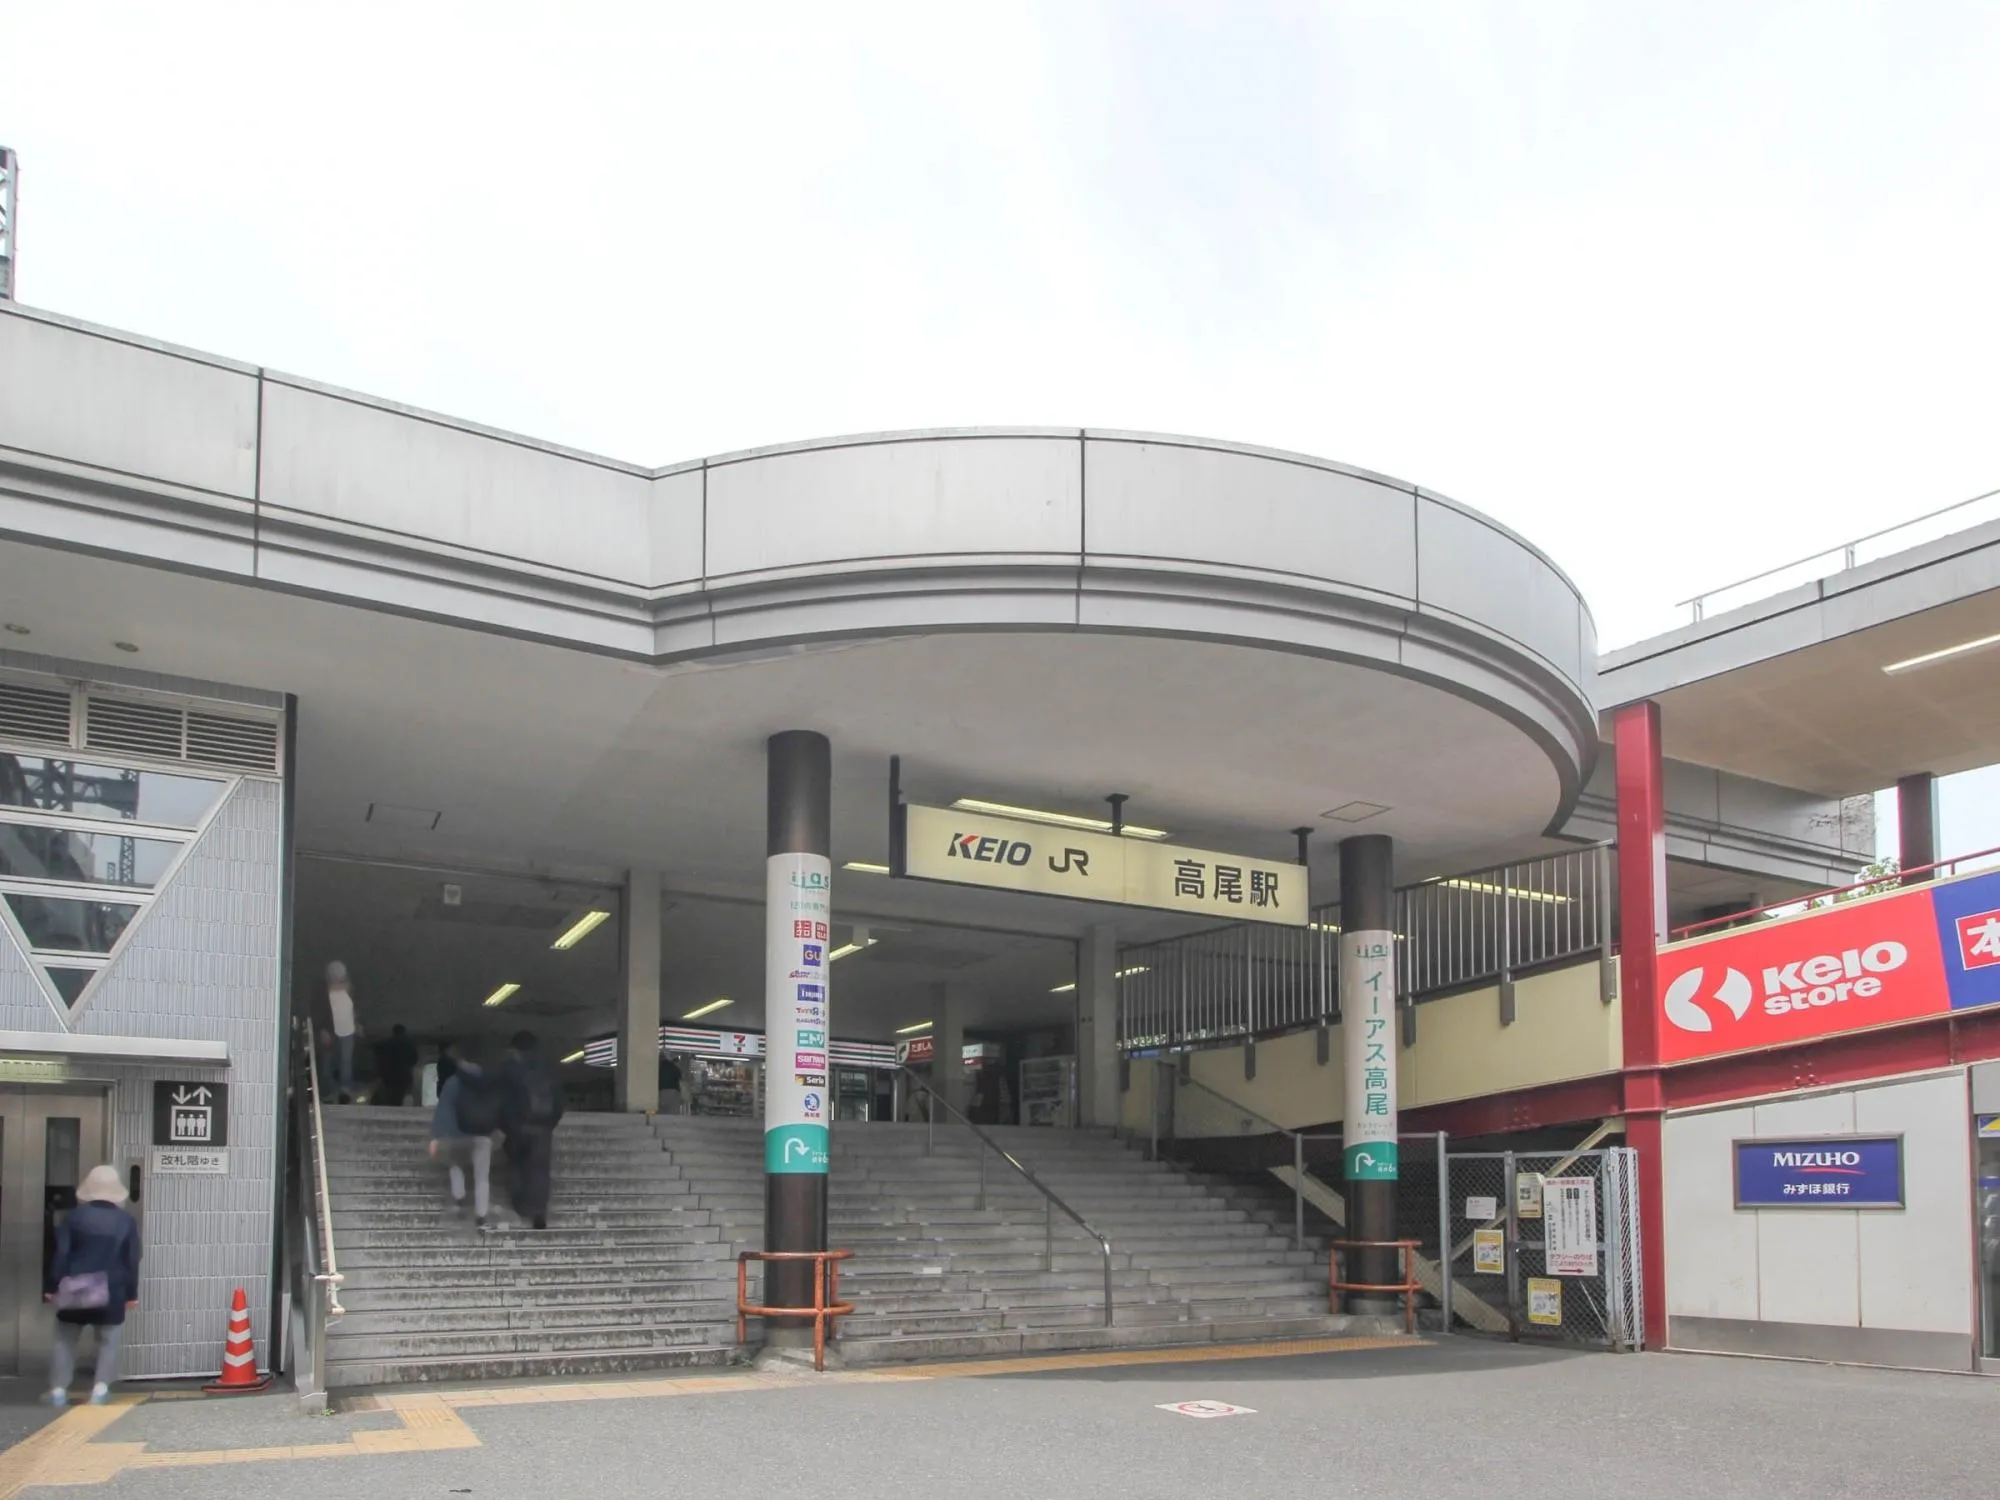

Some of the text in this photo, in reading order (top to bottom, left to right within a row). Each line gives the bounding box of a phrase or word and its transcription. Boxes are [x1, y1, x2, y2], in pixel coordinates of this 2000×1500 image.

[947, 832, 1089, 876] KEIO JR
[1174, 858, 1280, 909] 高尾駅
[804, 950, 821, 961] GU
[1764, 976, 1882, 1016] store
[799, 1032, 824, 1046] ニトリ
[1364, 971, 1388, 1116] イーアス高尾
[806, 1076, 825, 1085] Seria
[161, 1154, 220, 1166] 改札階ゆき
[1773, 1151, 1860, 1168] MIZUHO
[1783, 1182, 1850, 1196] みずほ銀行
